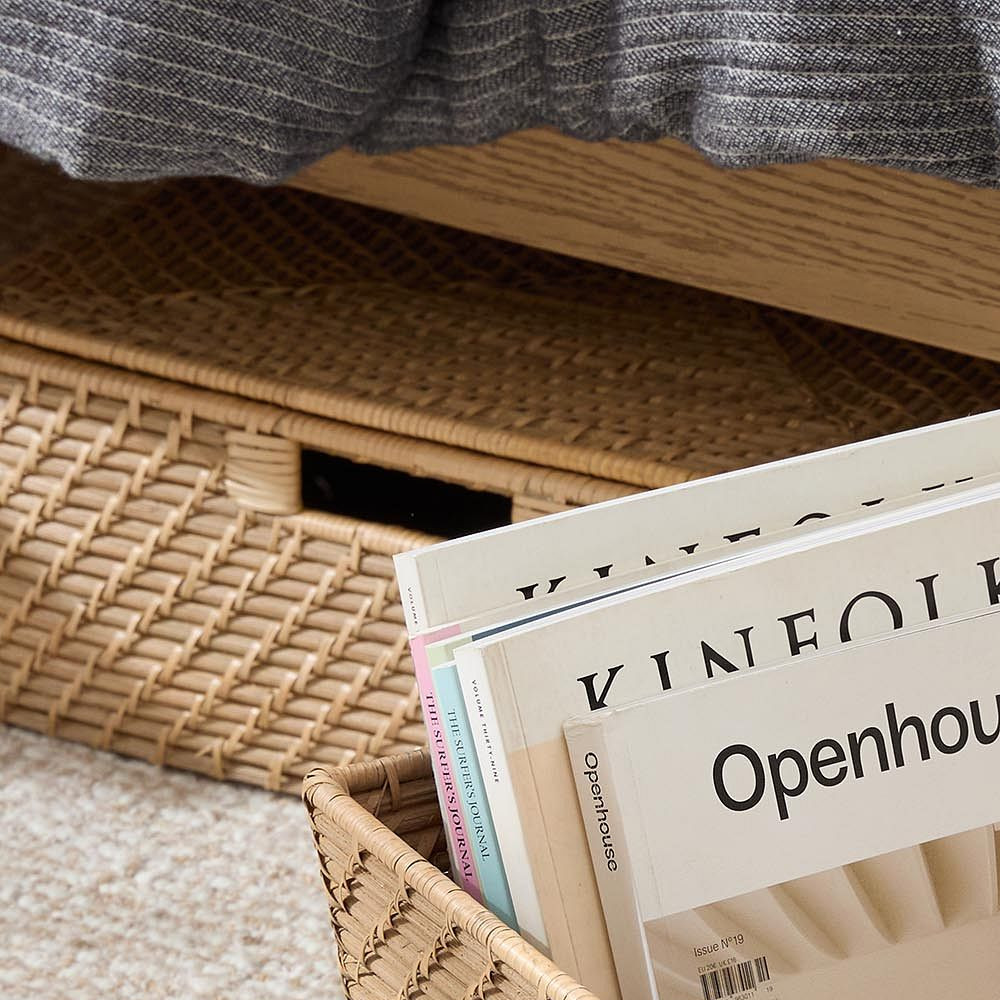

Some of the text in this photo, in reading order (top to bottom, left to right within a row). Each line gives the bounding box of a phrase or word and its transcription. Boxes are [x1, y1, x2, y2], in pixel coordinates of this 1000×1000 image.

[426, 691, 473, 881] THE SURFER'S JOURNAL
[447, 708, 490, 862] THE SURFER'S JOURNAL
[472, 680, 499, 783] VOLUME THIRTY-NINE
[584, 752, 618, 872] Openhouse
[693, 943, 720, 957] Issue
